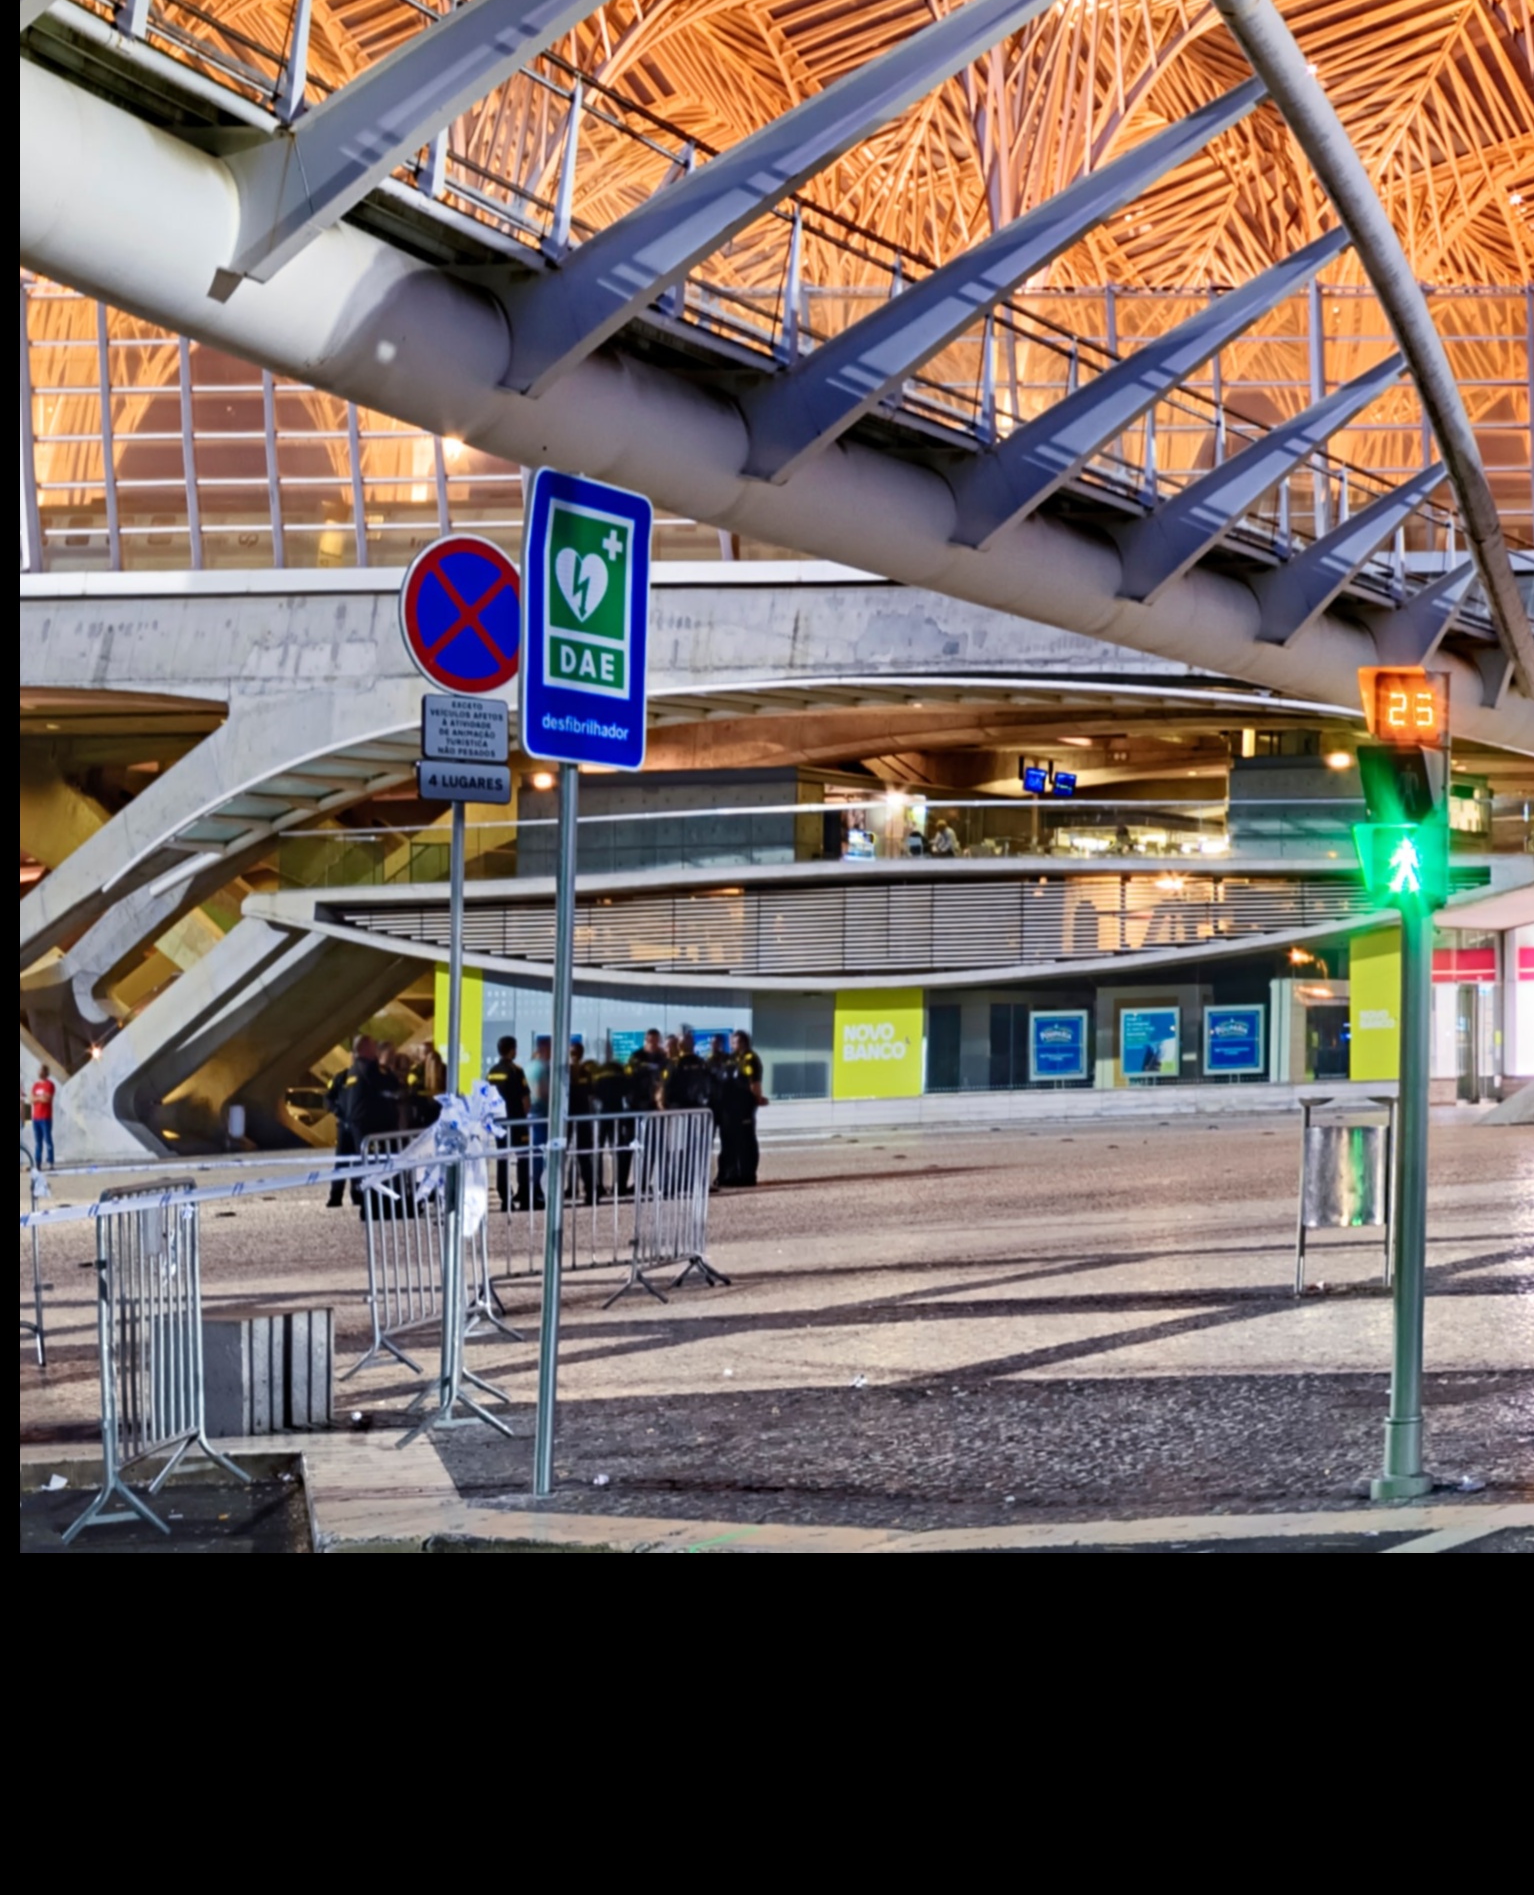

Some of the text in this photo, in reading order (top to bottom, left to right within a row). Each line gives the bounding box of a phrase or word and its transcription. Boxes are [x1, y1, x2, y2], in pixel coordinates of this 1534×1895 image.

[561, 645, 614, 682] DAE
[452, 701, 483, 710] EXCETO
[473, 712, 503, 721] AFETOS
[450, 720, 491, 729] ATIVIDADE
[542, 713, 629, 741] desfibrilhador
[439, 728, 495, 739] DE ANIMAÇÃO
[438, 746, 495, 757] NÃO PESADOS
[429, 774, 503, 791] 4 LUGARES
[844, 1023, 894, 1042] NOVO
[844, 1042, 906, 1062] BANCO
